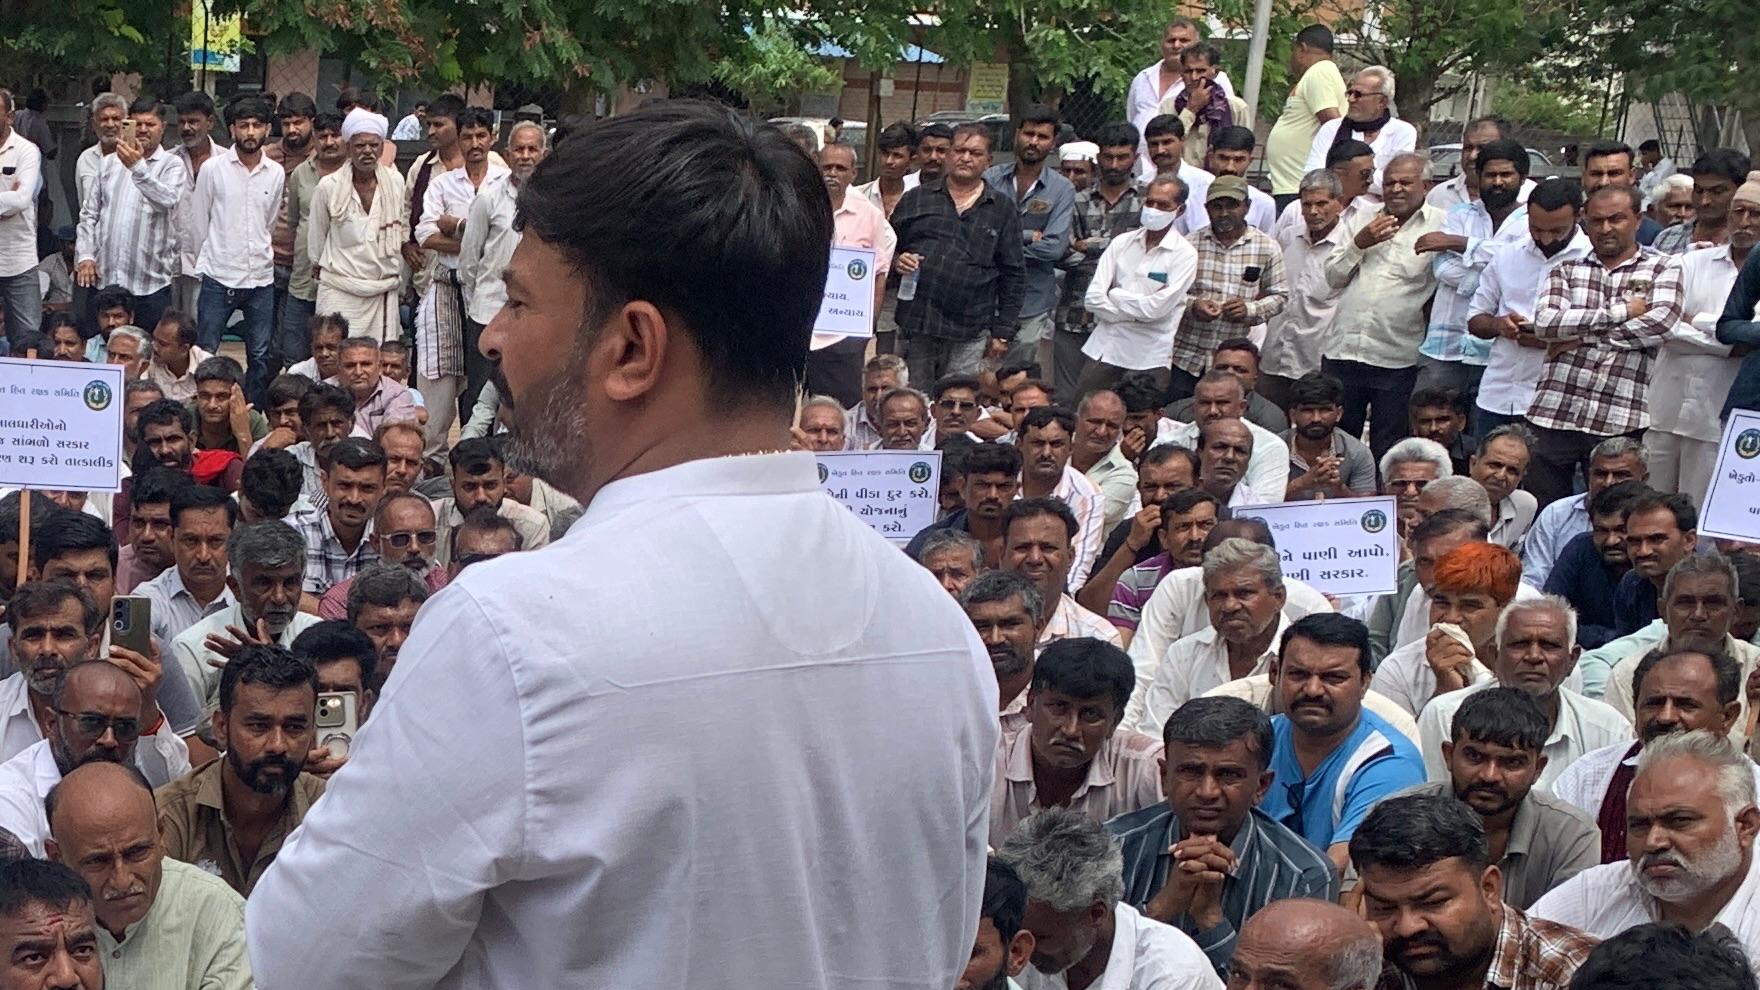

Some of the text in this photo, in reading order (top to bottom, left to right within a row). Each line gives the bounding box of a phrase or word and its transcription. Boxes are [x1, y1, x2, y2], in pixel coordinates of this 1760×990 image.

[56, 440, 90, 450] સરકાર
[41, 453, 58, 465] કરો
[1302, 547, 1338, 561] પાણી
[1347, 543, 1390, 558] આપો.
[1319, 567, 1369, 580] સરકાર.
